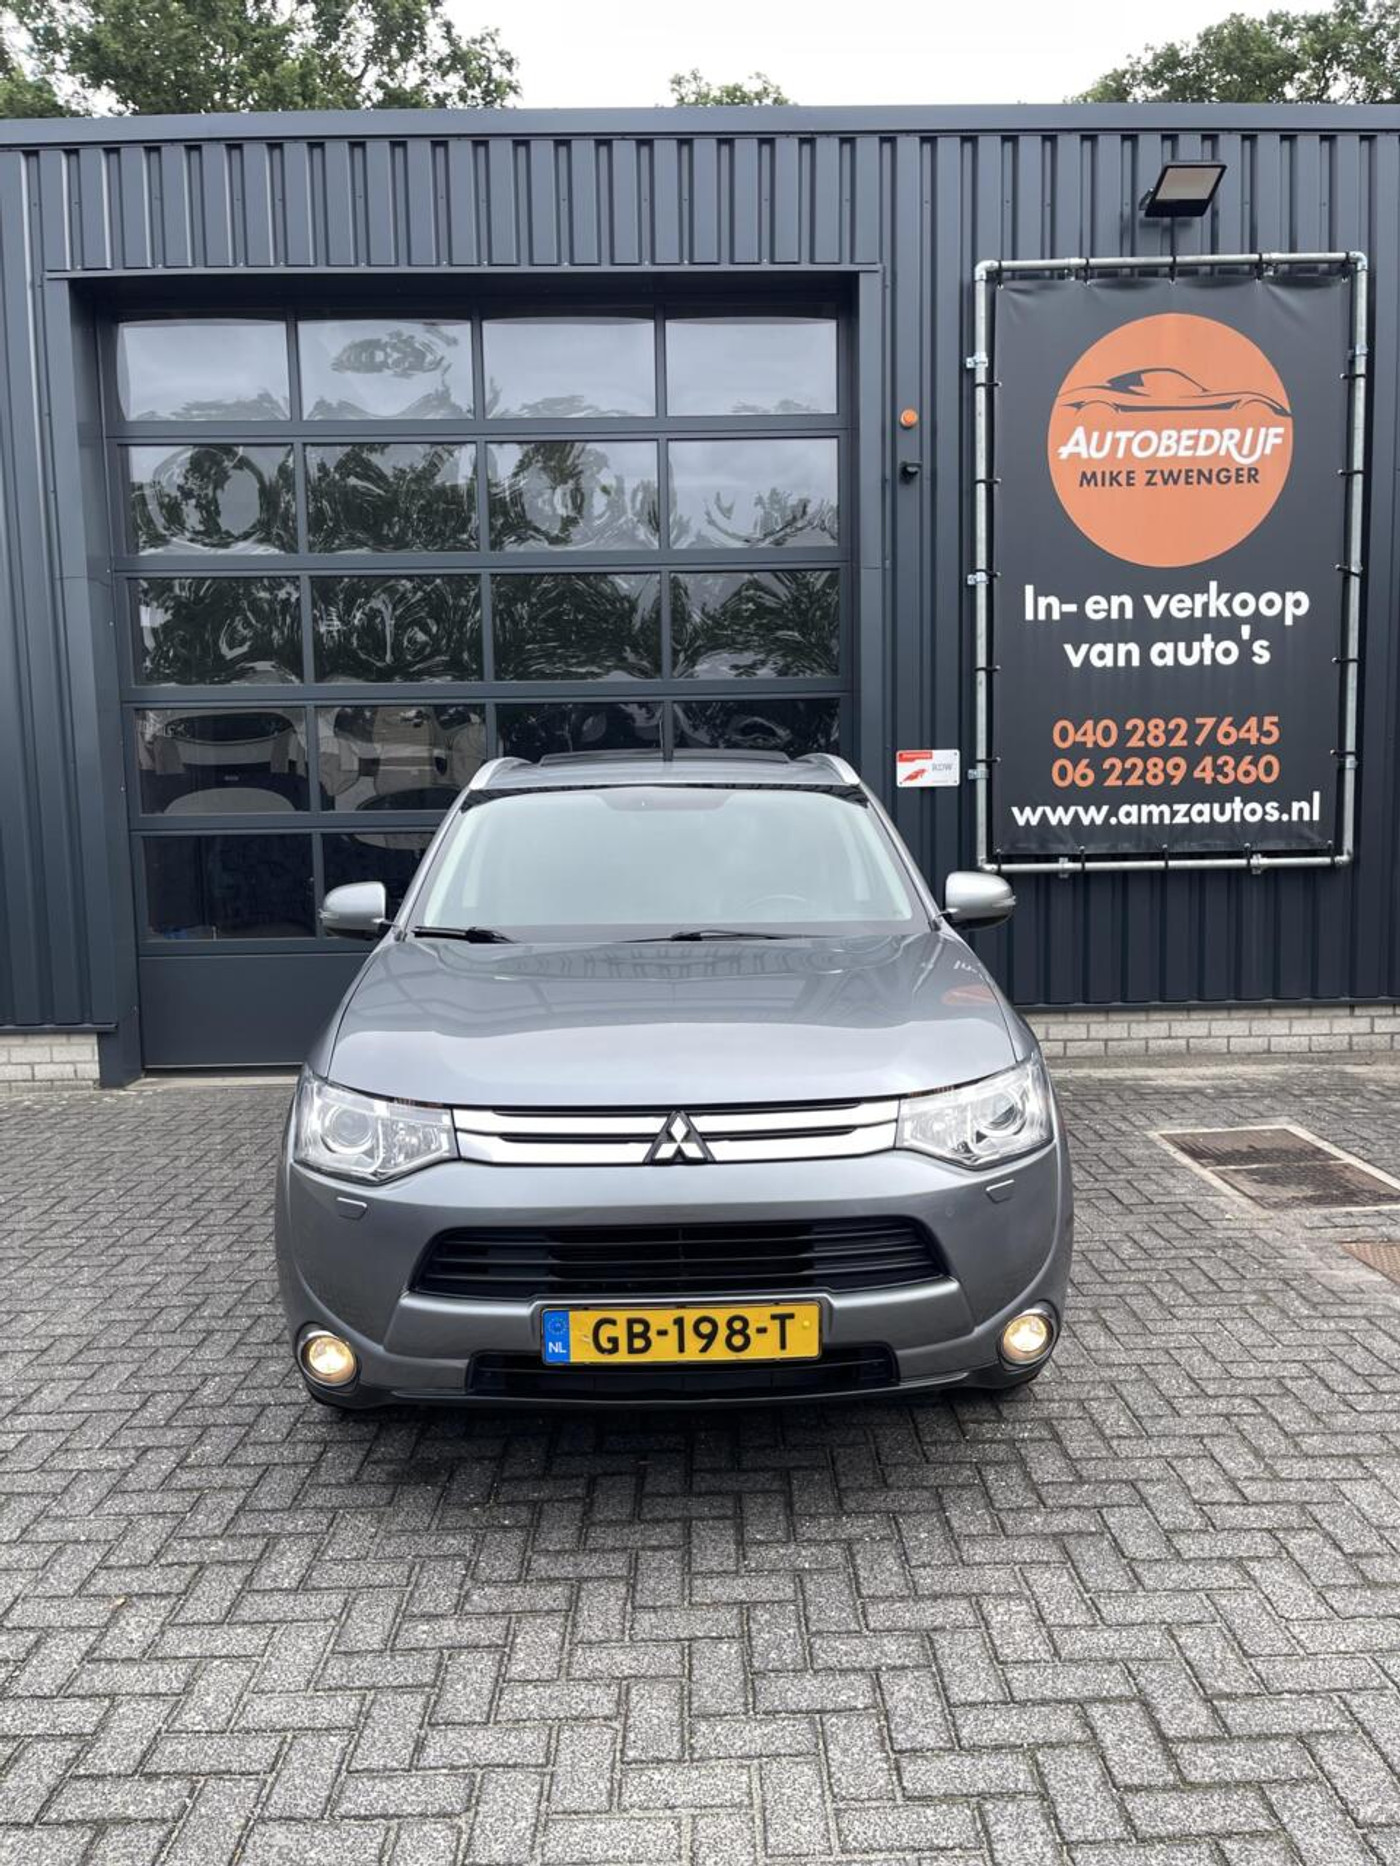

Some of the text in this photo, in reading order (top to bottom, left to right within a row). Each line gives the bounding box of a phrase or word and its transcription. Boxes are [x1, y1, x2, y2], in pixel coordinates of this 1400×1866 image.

[1058, 426, 1285, 464] AUTOBEDRIJF
[1079, 466, 1260, 487] MIKE ZWENGER
[1024, 580, 1310, 626] In- en verkoop
[1063, 624, 1271, 668] van auto's
[1051, 714, 1281, 750] 040 282 7645
[1051, 753, 1281, 788] 06 2289 4360
[1011, 791, 1321, 827] www.amzautos.nl
[548, 1341, 567, 1354] NL
[592, 1313, 796, 1355] GB-198-T
